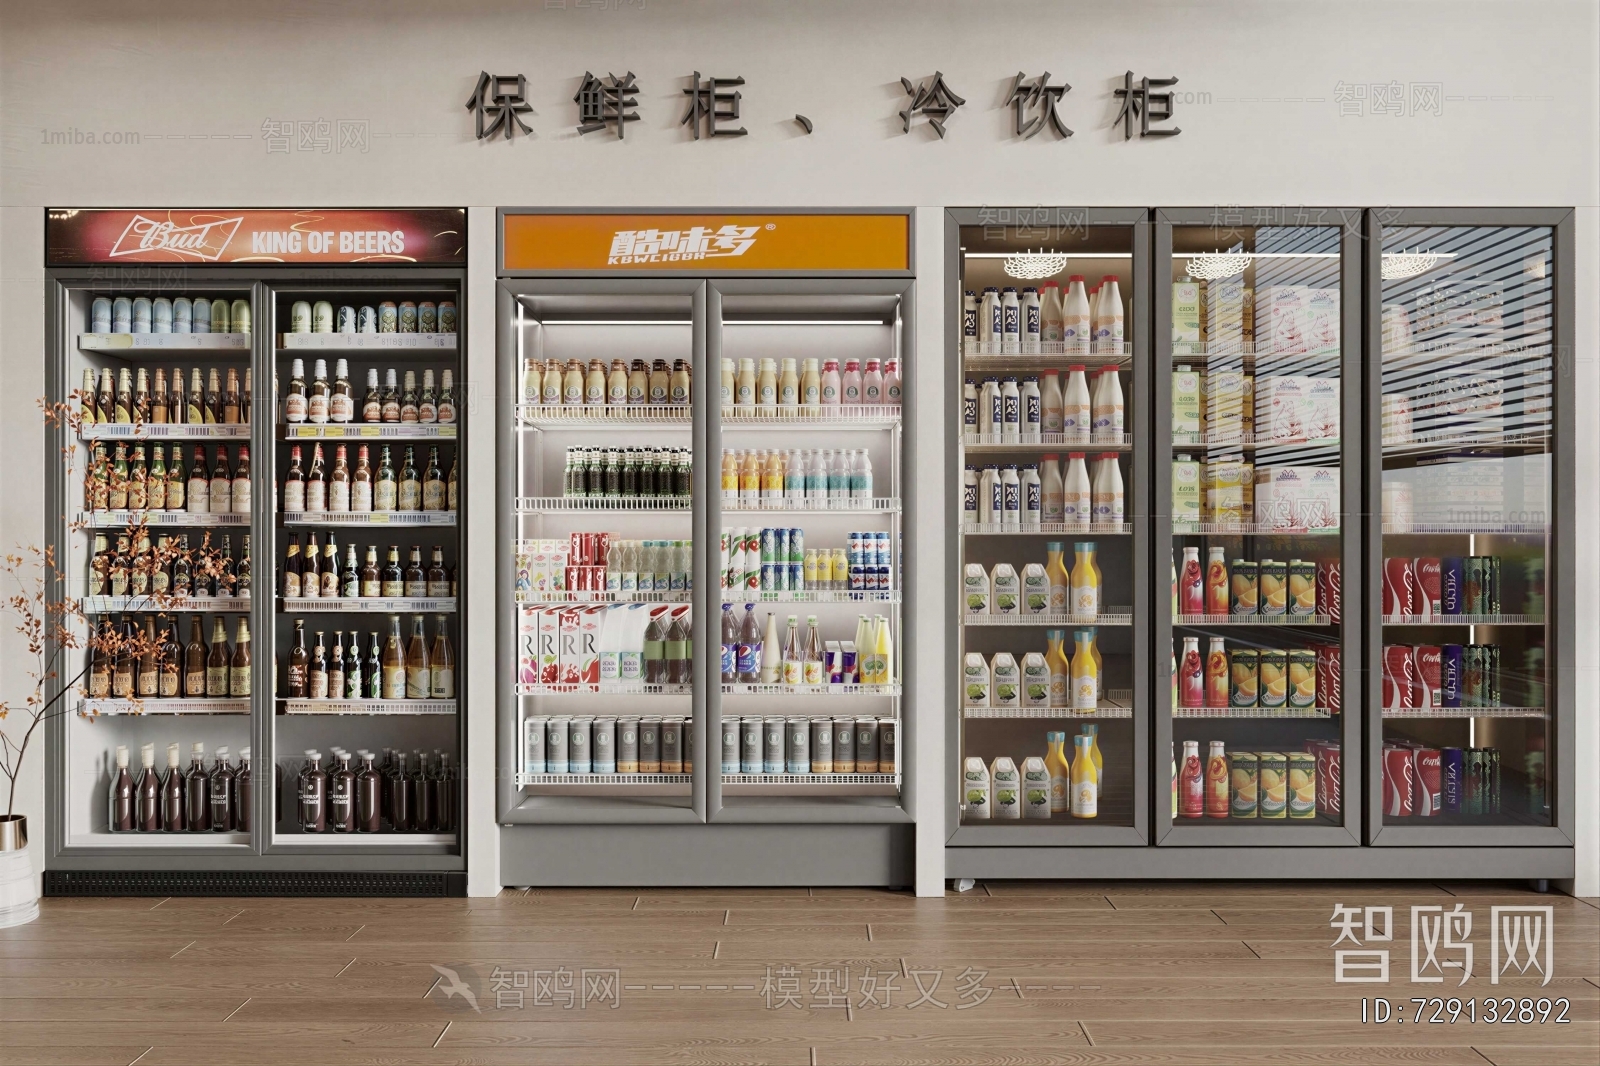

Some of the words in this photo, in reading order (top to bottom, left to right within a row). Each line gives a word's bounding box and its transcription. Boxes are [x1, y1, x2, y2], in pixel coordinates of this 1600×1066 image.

[133, 221, 211, 249] Bud
[252, 231, 302, 254] KING
[307, 231, 335, 254] OF
[339, 230, 405, 254] BEERS
